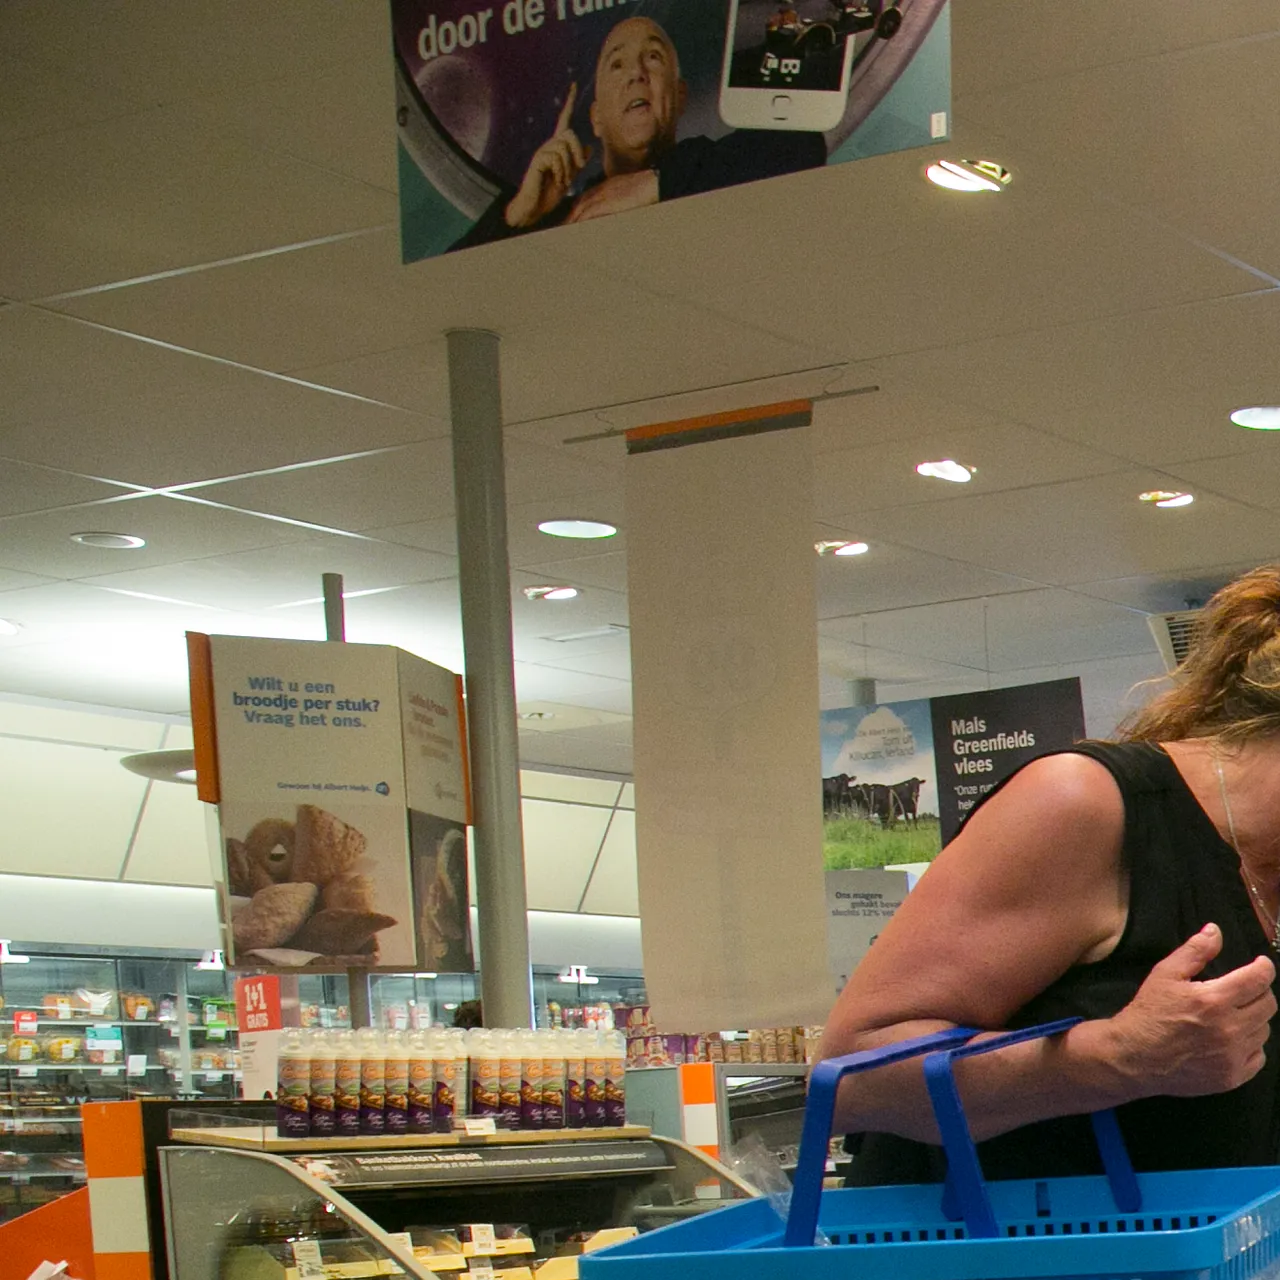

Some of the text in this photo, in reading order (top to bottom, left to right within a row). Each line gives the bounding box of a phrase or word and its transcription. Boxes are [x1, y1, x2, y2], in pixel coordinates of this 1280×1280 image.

[418, 8, 494, 60] door
[503, 0, 545, 35] de
[248, 677, 335, 694] Wilt u een
[233, 692, 380, 713] broodje per stuk?
[244, 710, 366, 728] Vraag het ons.
[952, 717, 987, 736] Mals
[953, 731, 1035, 756] Greenfields
[954, 757, 993, 775] vlees
[979, 782, 998, 795] run
[244, 982, 267, 1012] 1+1
